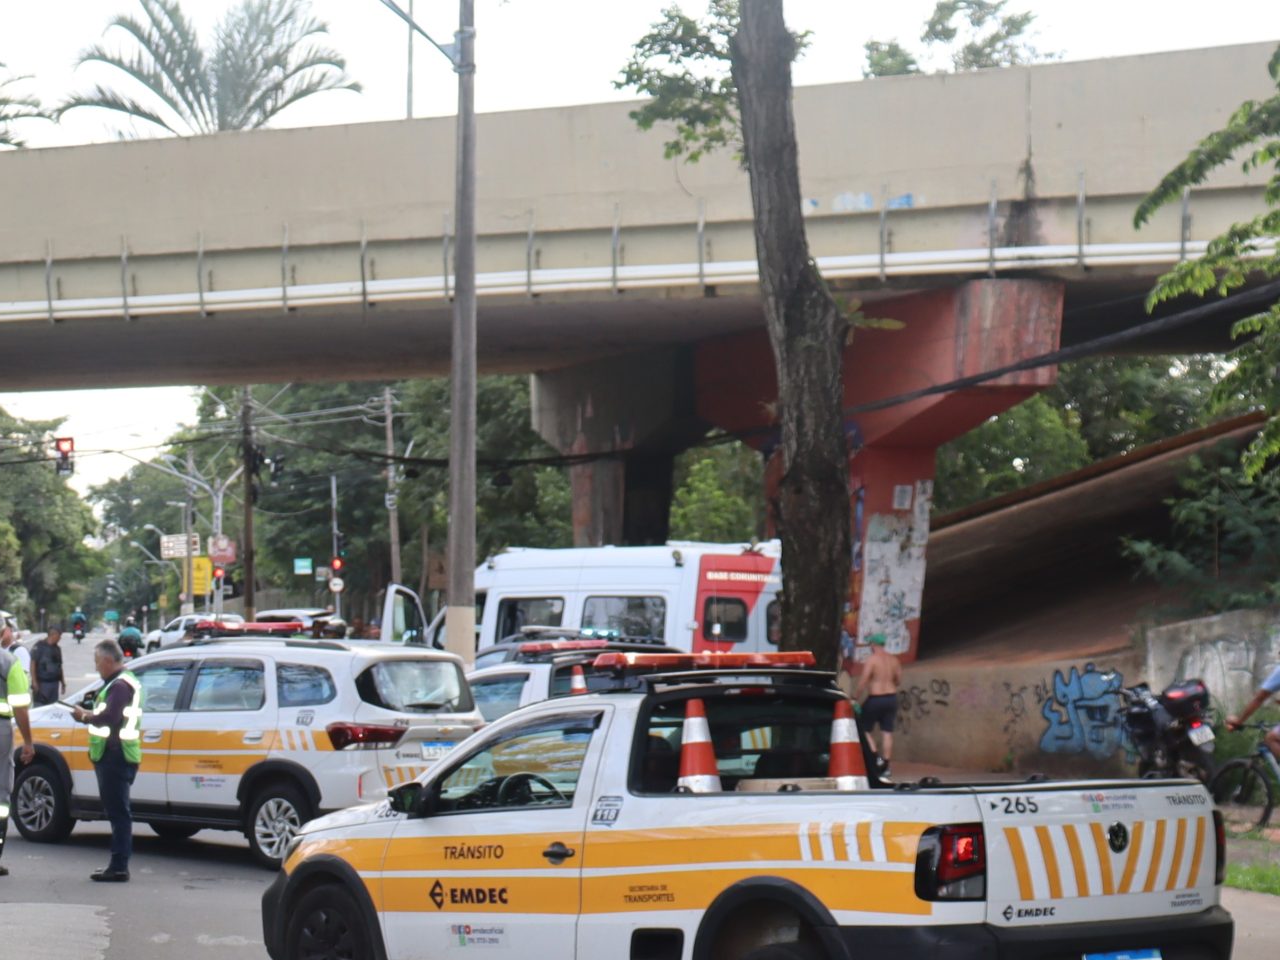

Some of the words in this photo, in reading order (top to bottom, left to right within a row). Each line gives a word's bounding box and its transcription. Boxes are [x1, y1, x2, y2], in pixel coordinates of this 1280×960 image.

[1001, 797, 1038, 814] 265
[443, 843, 504, 860] TRÂNSITO
[450, 888, 508, 904] EMDEC
[624, 893, 675, 903] TRANSPORTES
[1017, 907, 1055, 918] EMDEC
